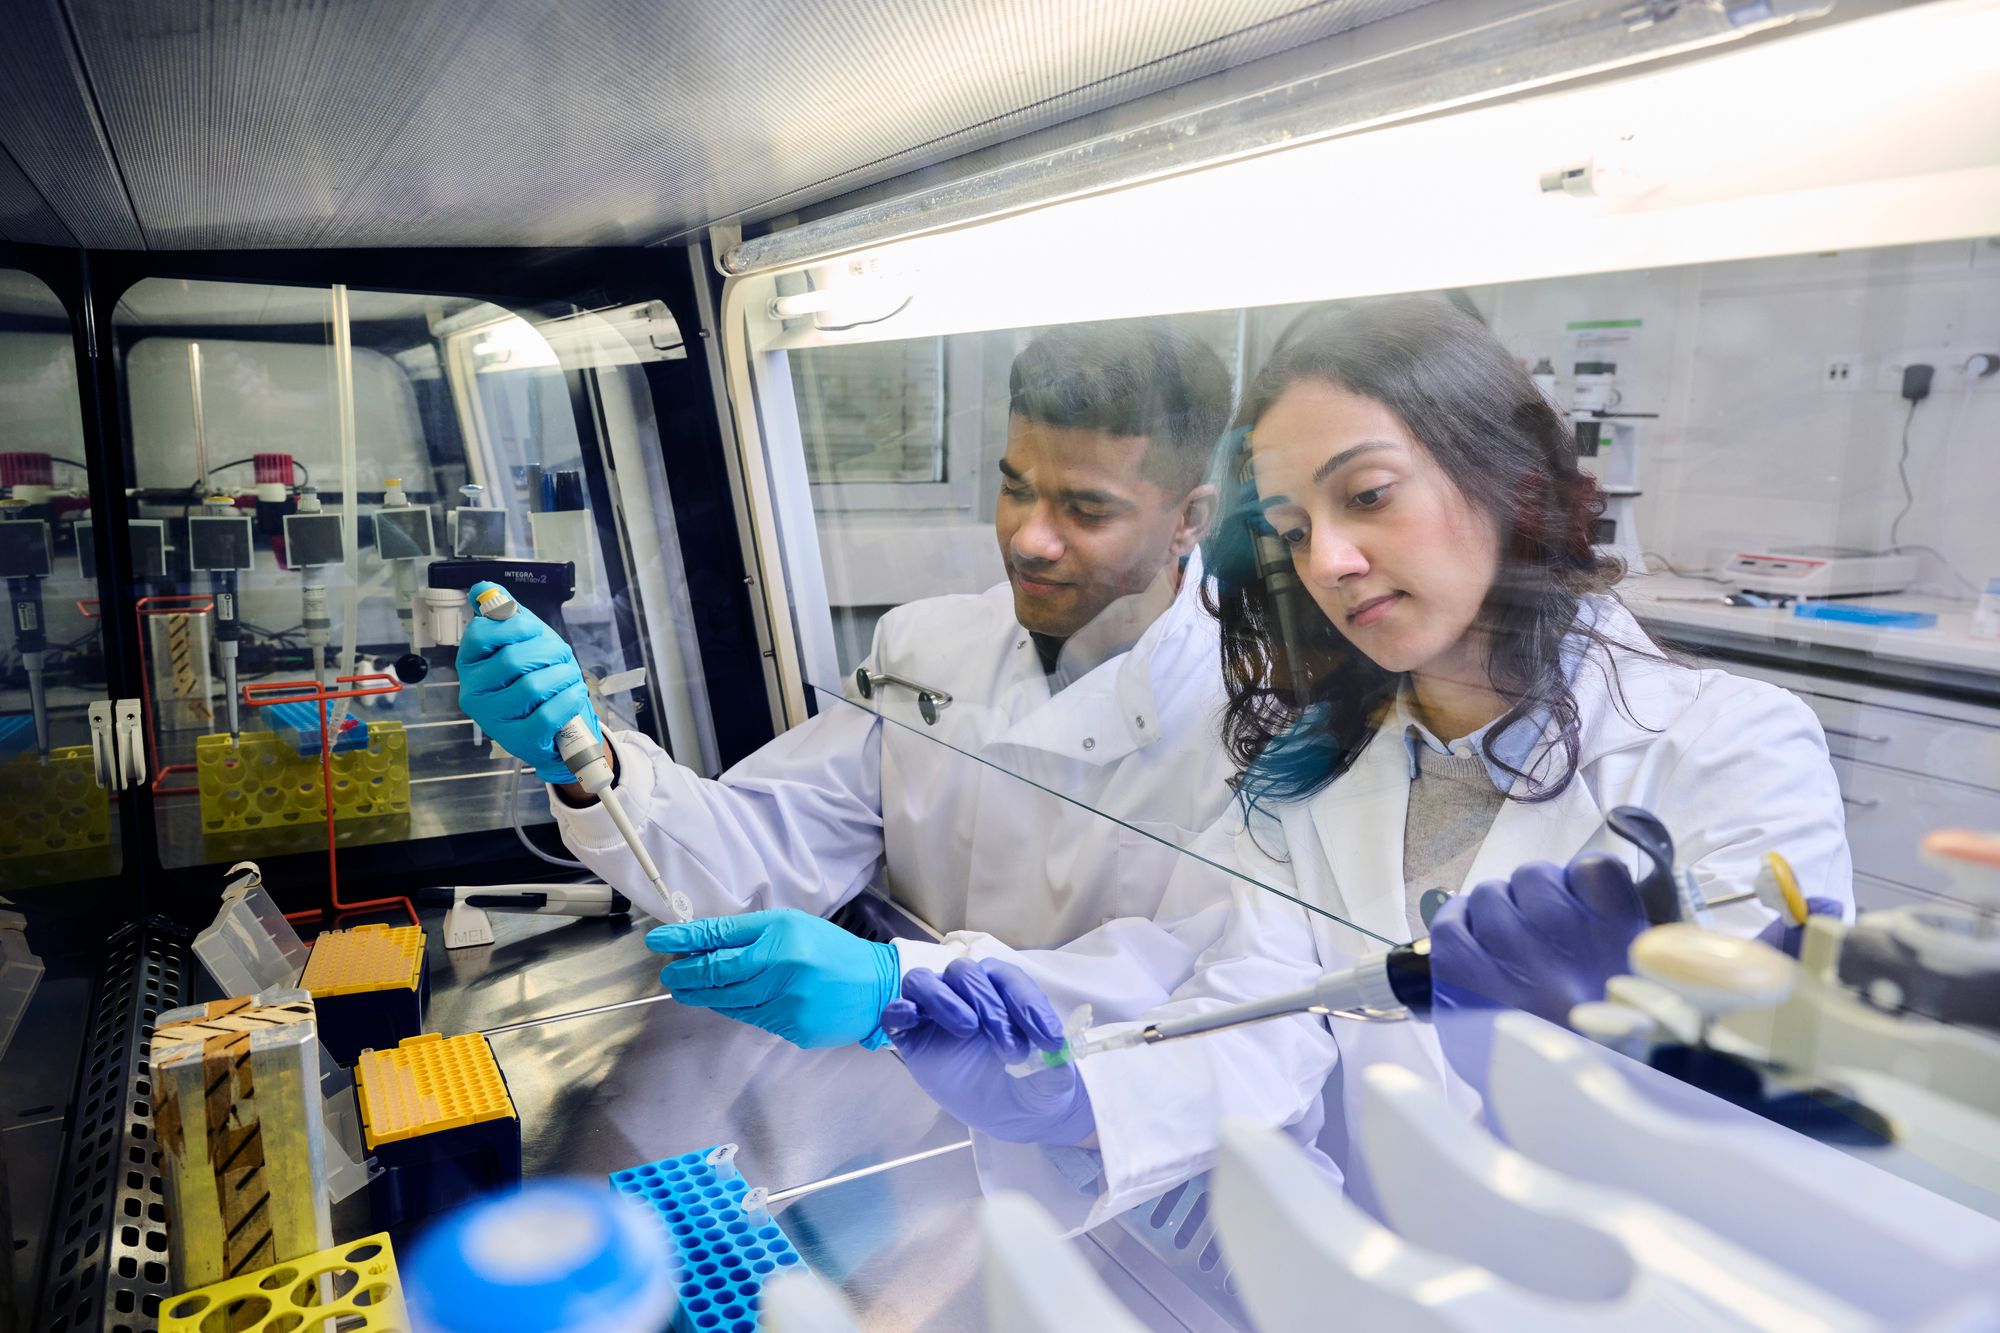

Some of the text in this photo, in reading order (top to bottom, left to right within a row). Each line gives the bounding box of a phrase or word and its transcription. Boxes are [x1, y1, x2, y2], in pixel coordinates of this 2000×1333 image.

[504, 570, 534, 578] INTEGRA
[540, 574, 547, 584] 2
[454, 929, 489, 945] MEL
